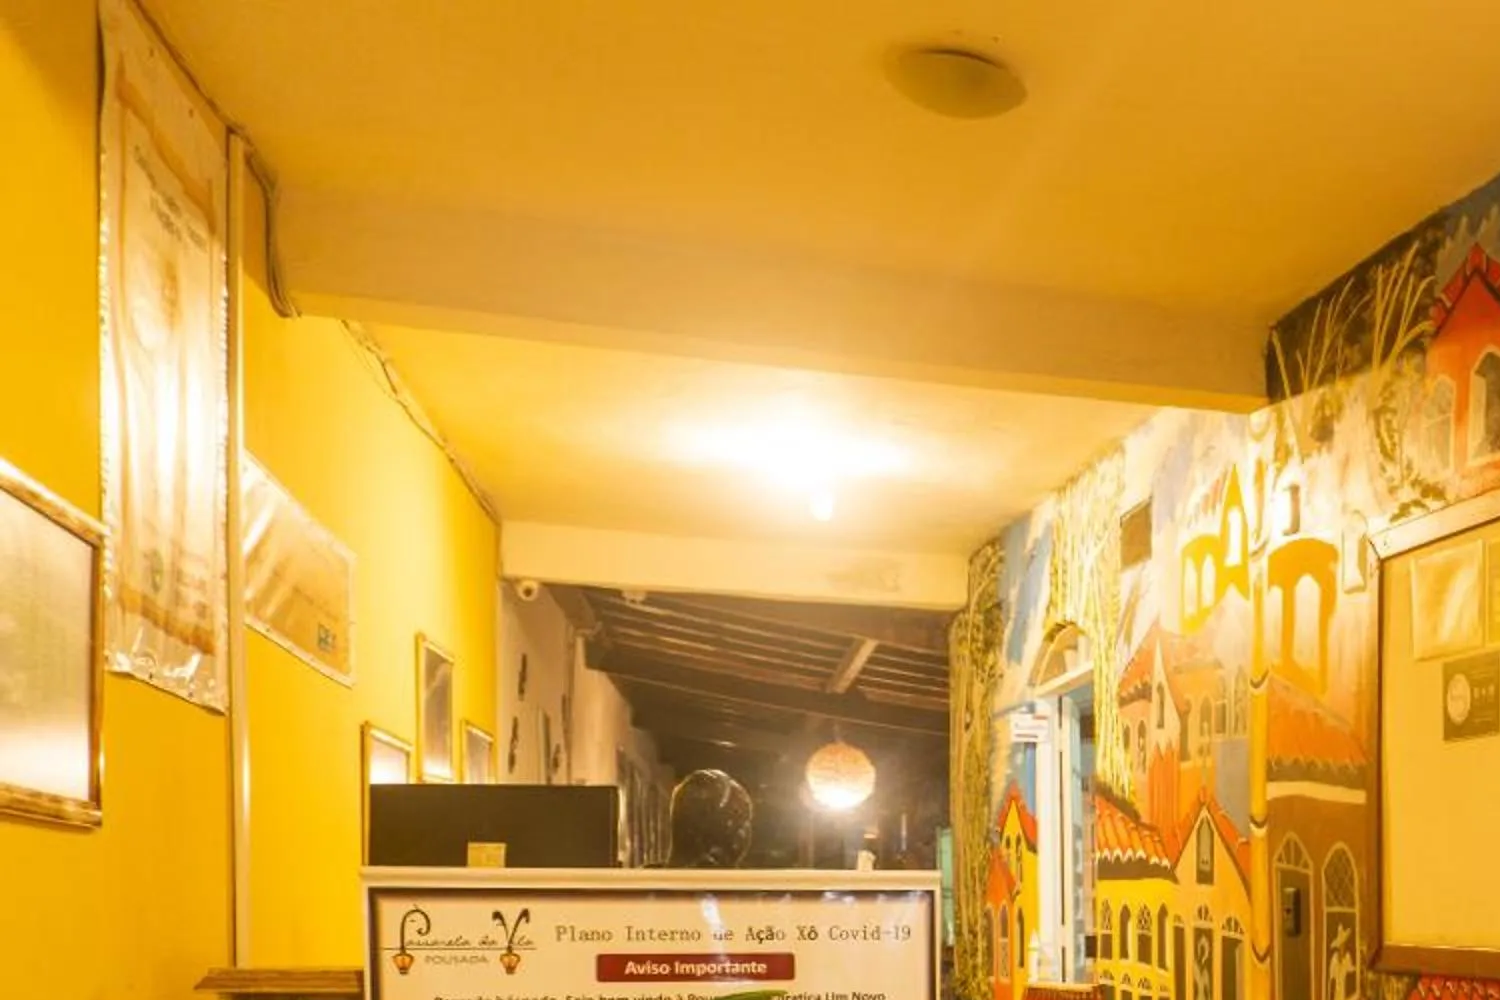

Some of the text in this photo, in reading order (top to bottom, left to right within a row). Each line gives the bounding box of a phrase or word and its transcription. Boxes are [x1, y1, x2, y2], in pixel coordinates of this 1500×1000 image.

[555, 925, 614, 943] Plano
[626, 925, 702, 942] Interno
[745, 924, 787, 944] Ação
[797, 924, 819, 941] Xô
[828, 924, 912, 942] Covid-19
[424, 954, 491, 966] POUSADA
[624, 960, 768, 977] Aviso Importante
